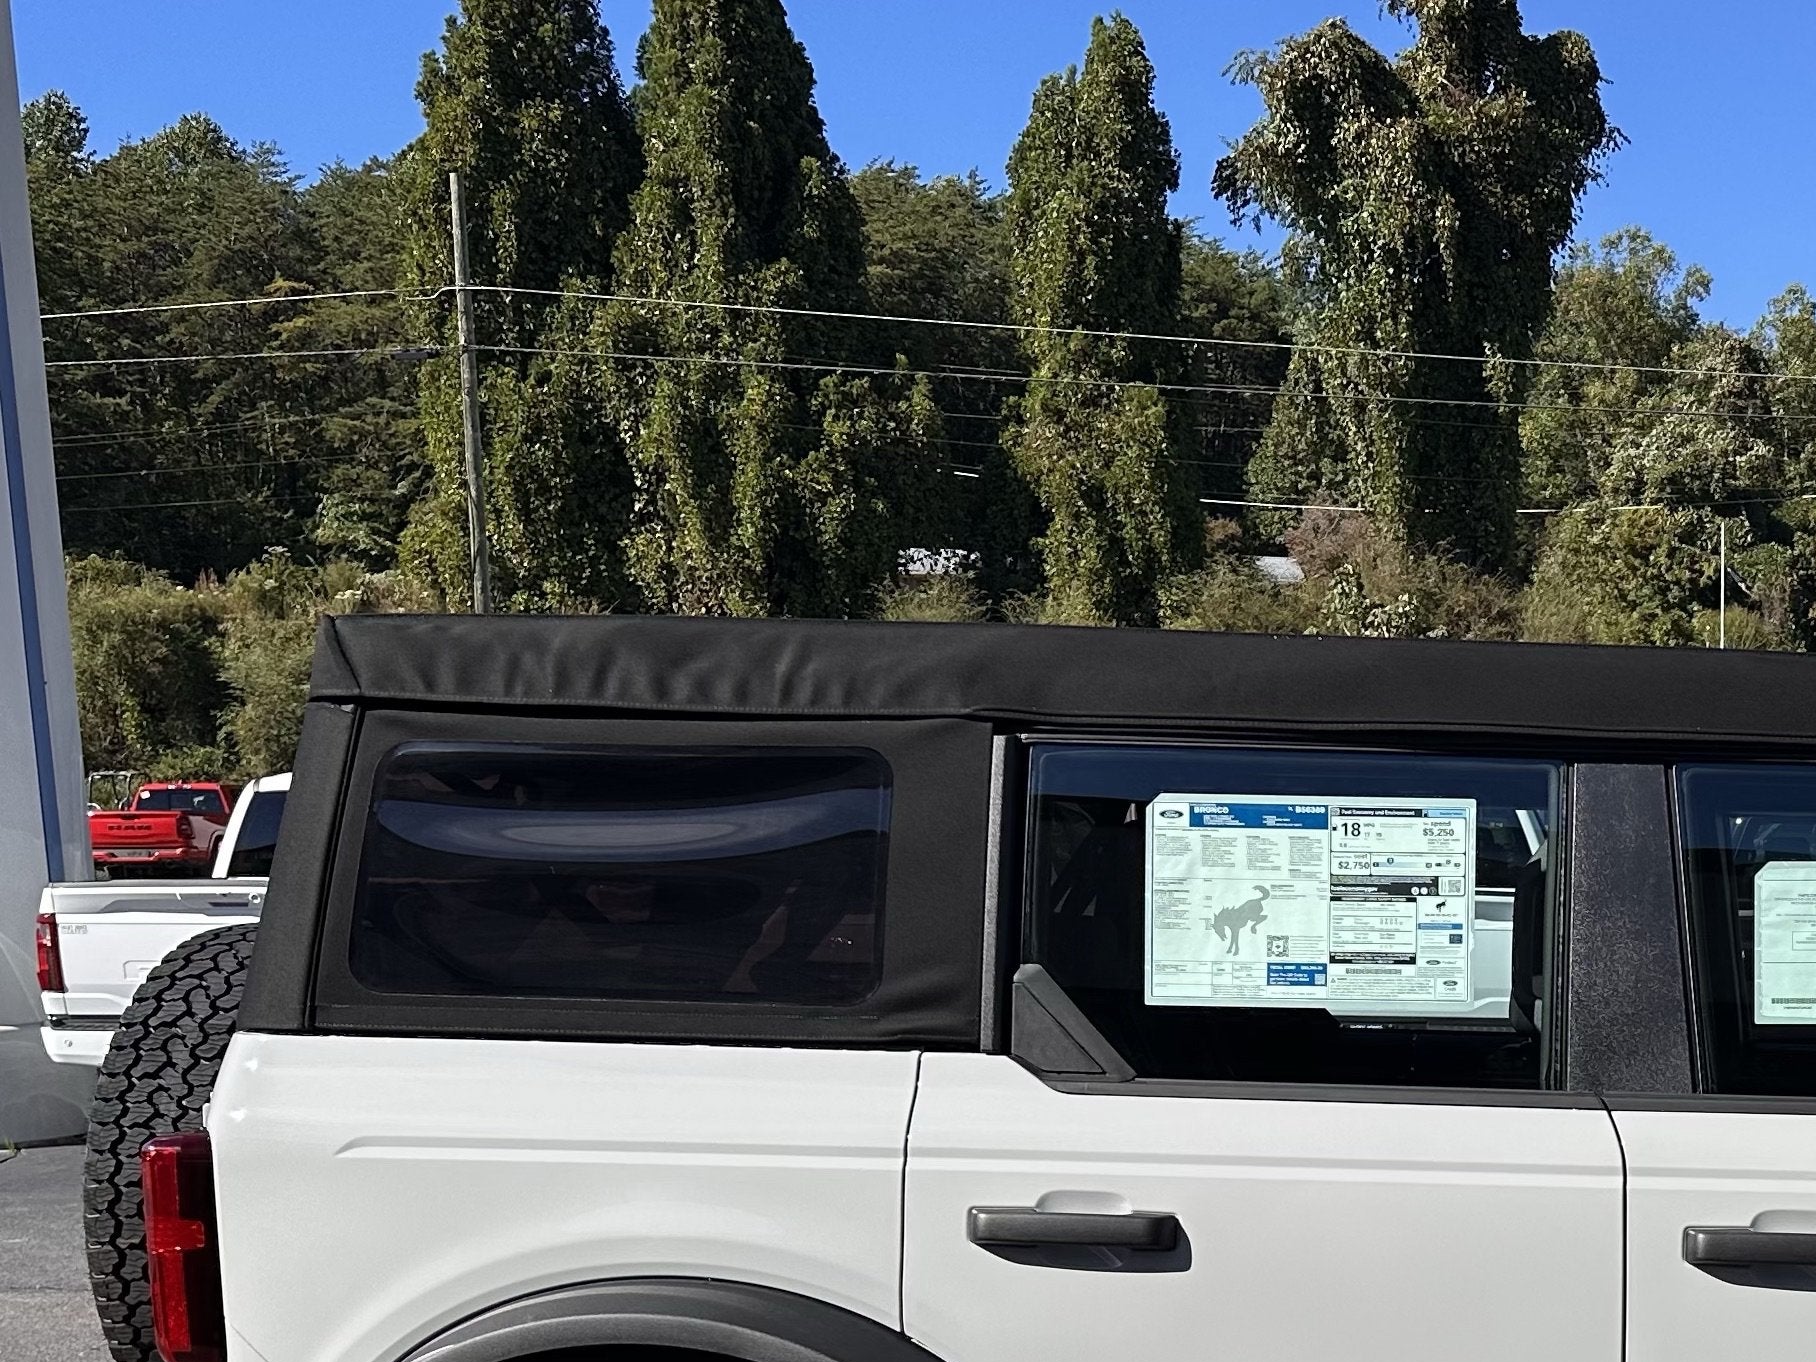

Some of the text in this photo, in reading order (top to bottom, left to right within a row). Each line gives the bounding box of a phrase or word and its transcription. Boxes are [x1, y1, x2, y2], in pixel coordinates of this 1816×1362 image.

[1341, 822, 1361, 837] 18
[1423, 828, 1455, 837] $5,250
[1338, 862, 1371, 870] $2,750
